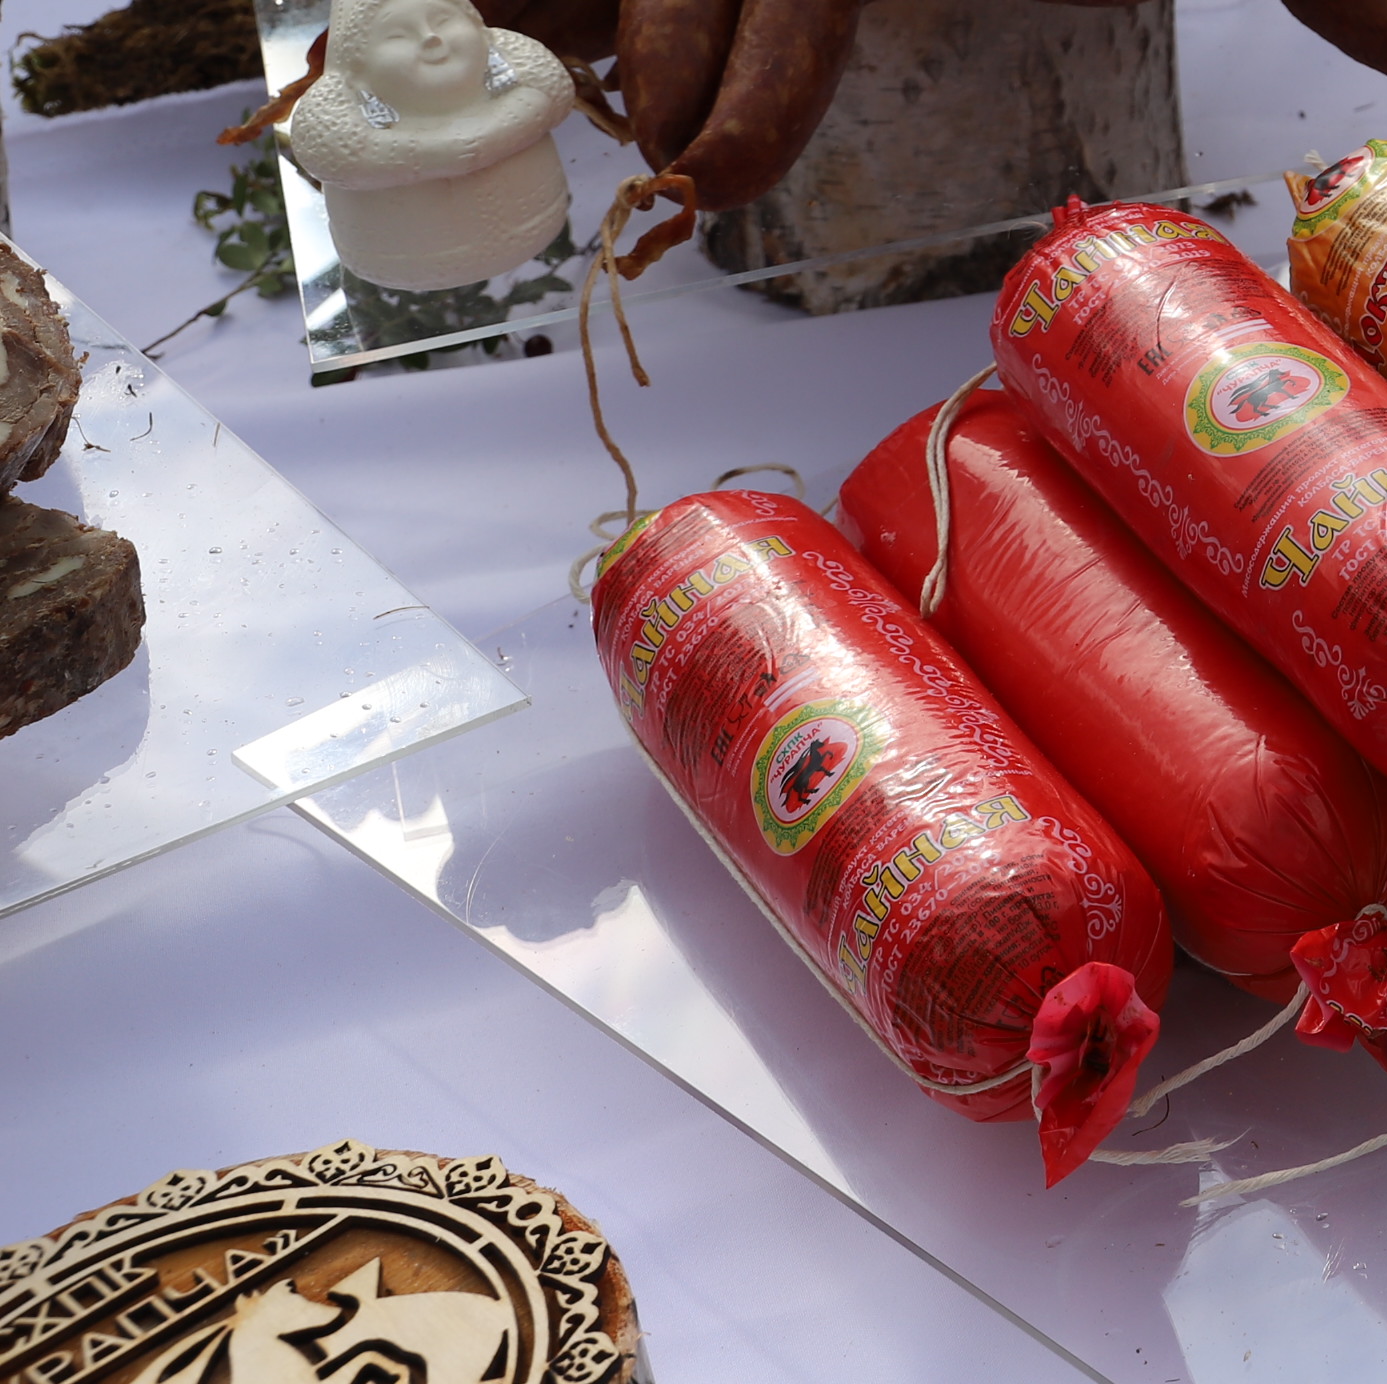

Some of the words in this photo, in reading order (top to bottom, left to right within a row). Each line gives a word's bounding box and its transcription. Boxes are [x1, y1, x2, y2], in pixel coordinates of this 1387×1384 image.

[1070, 289, 1108, 326] ГОСТ
[1296, 464, 1349, 509] КОЛБАСА
[1240, 492, 1297, 598] Мясосодержащий
[1293, 455, 1339, 495] продукт
[1330, 538, 1355, 563] ТР
[1338, 539, 1377, 582] ГОСТ
[657, 643, 677, 668] ТС
[766, 719, 826, 785] "ЧУРАПЧА"
[772, 730, 805, 765] СХПК
[871, 946, 888, 970] ТР
[880, 917, 902, 943] ТС
[879, 946, 904, 991] ГОСТ
